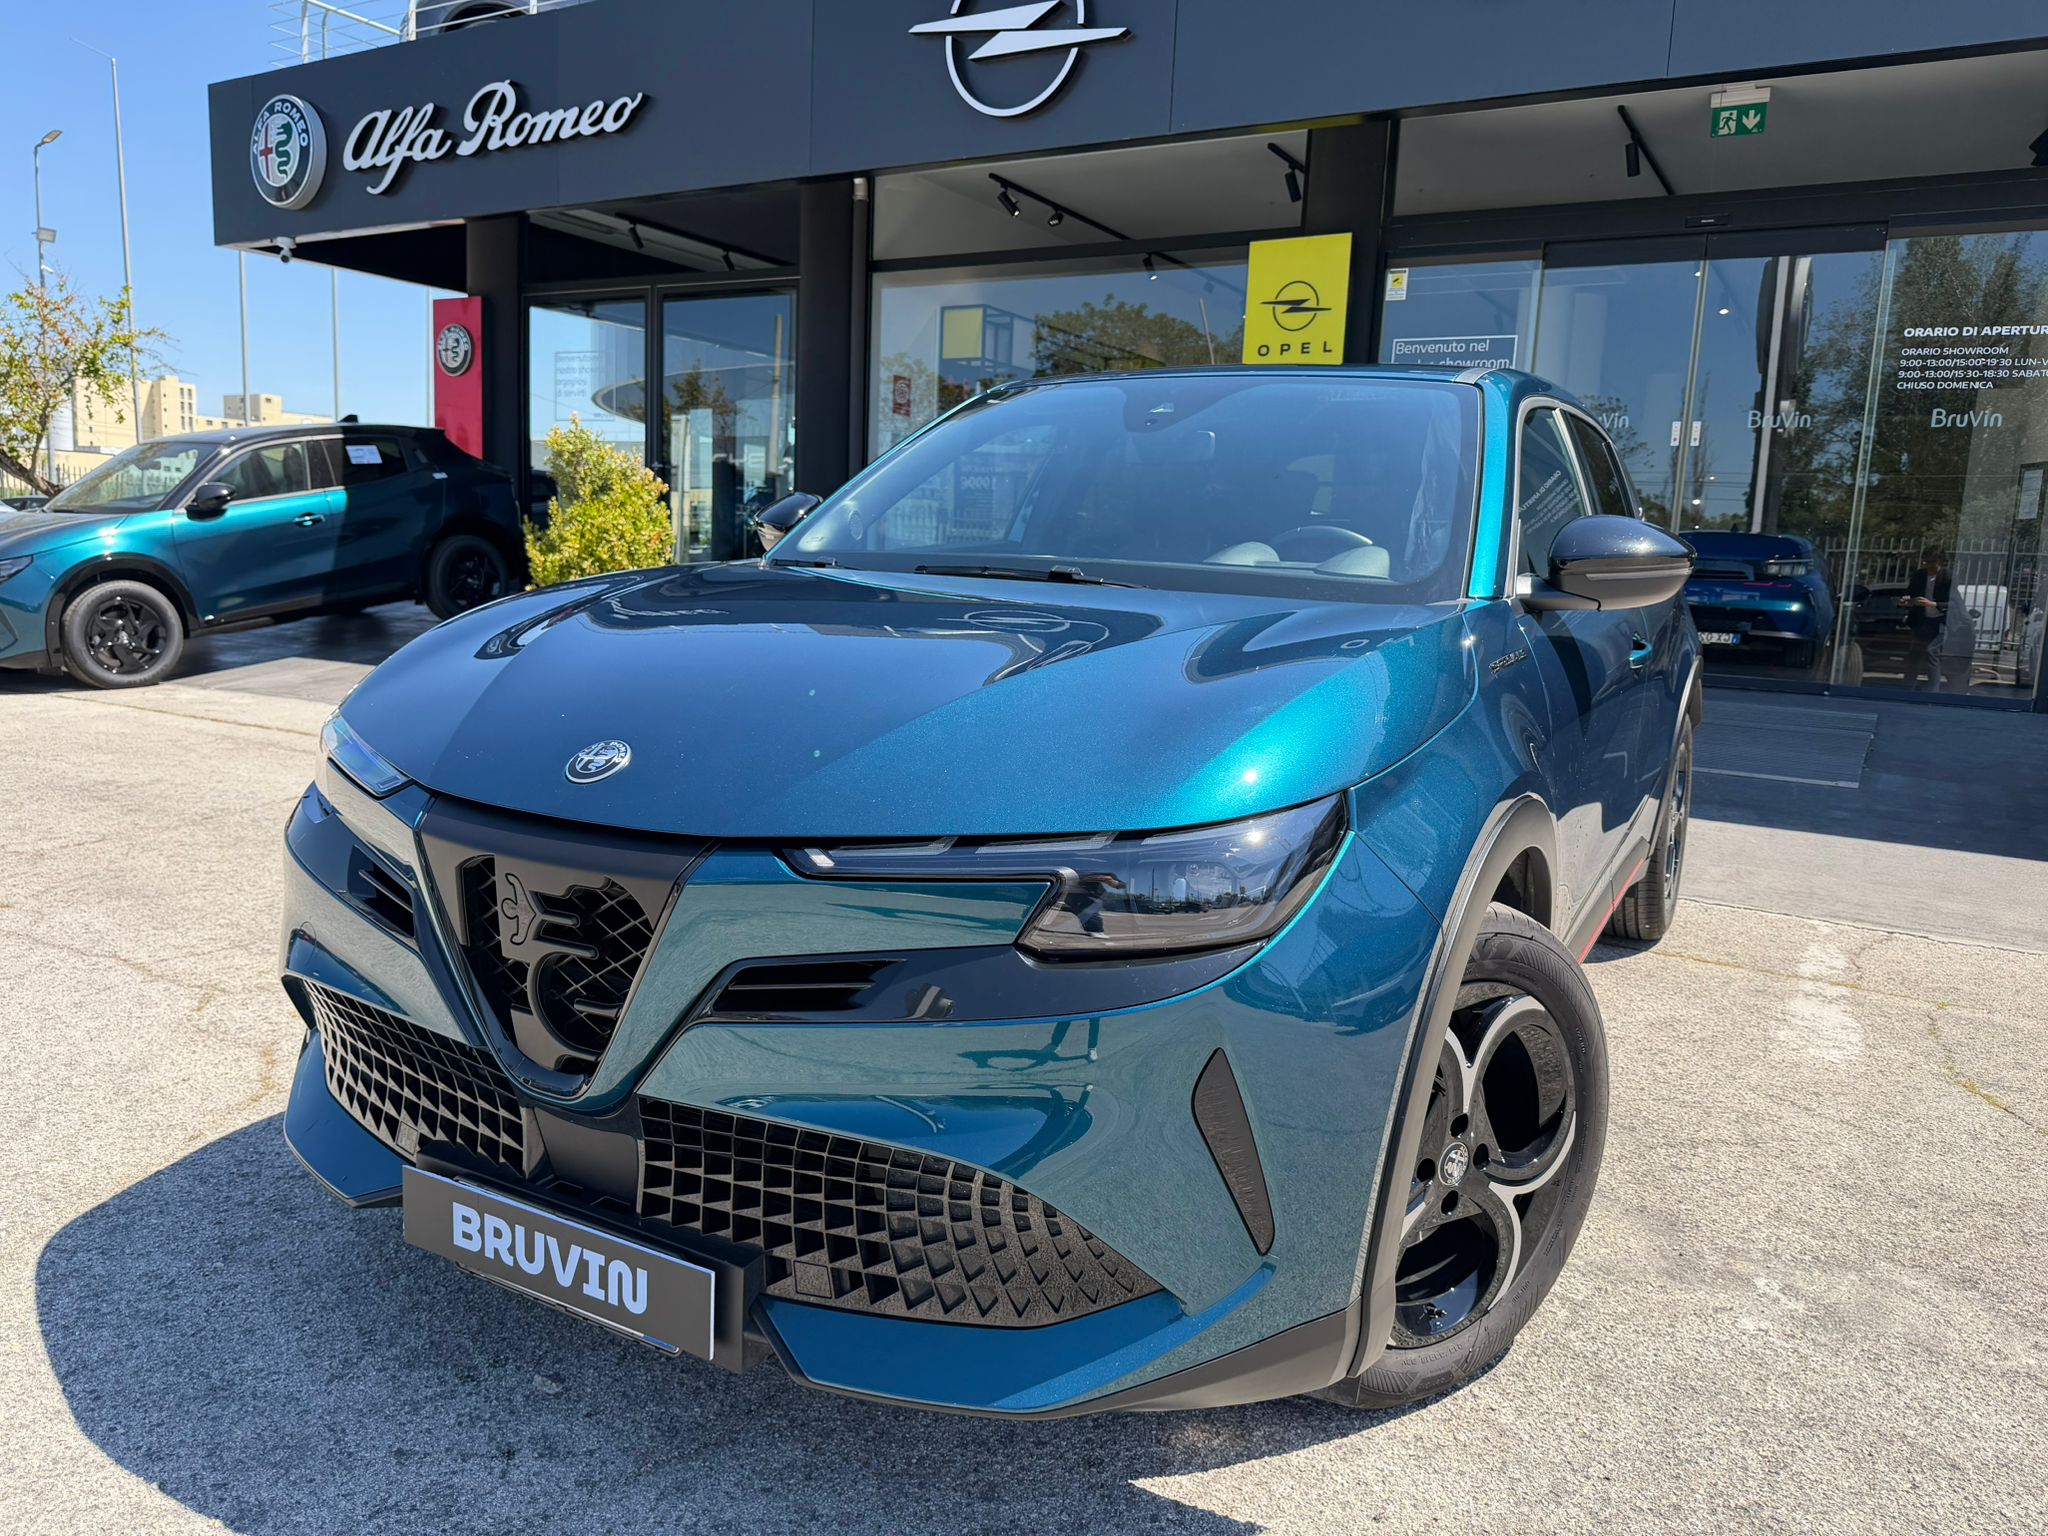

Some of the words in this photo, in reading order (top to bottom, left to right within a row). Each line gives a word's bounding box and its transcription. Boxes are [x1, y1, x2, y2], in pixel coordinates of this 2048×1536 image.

[274, 102, 309, 147] ROMEO
[343, 102, 452, 195] Alfa
[456, 80, 643, 156] Romeo
[1904, 326, 1960, 338] ORARIO
[1962, 326, 1978, 337] DI
[1257, 341, 1333, 357] OPEL
[1396, 340, 1466, 354] Benvenuto
[1469, 339, 1490, 352] nel
[1901, 347, 1941, 356] ORARIO
[1943, 346, 2009, 356] SHOWROOM
[2012, 369, 2048, 378] SABAT
[1896, 381, 1935, 390] CHIUSO
[1937, 381, 1994, 390] DOMENICA
[1747, 410, 1812, 428] BruVin
[1930, 408, 2003, 428] BruVin
[453, 1201, 648, 1315] BRUVIN
